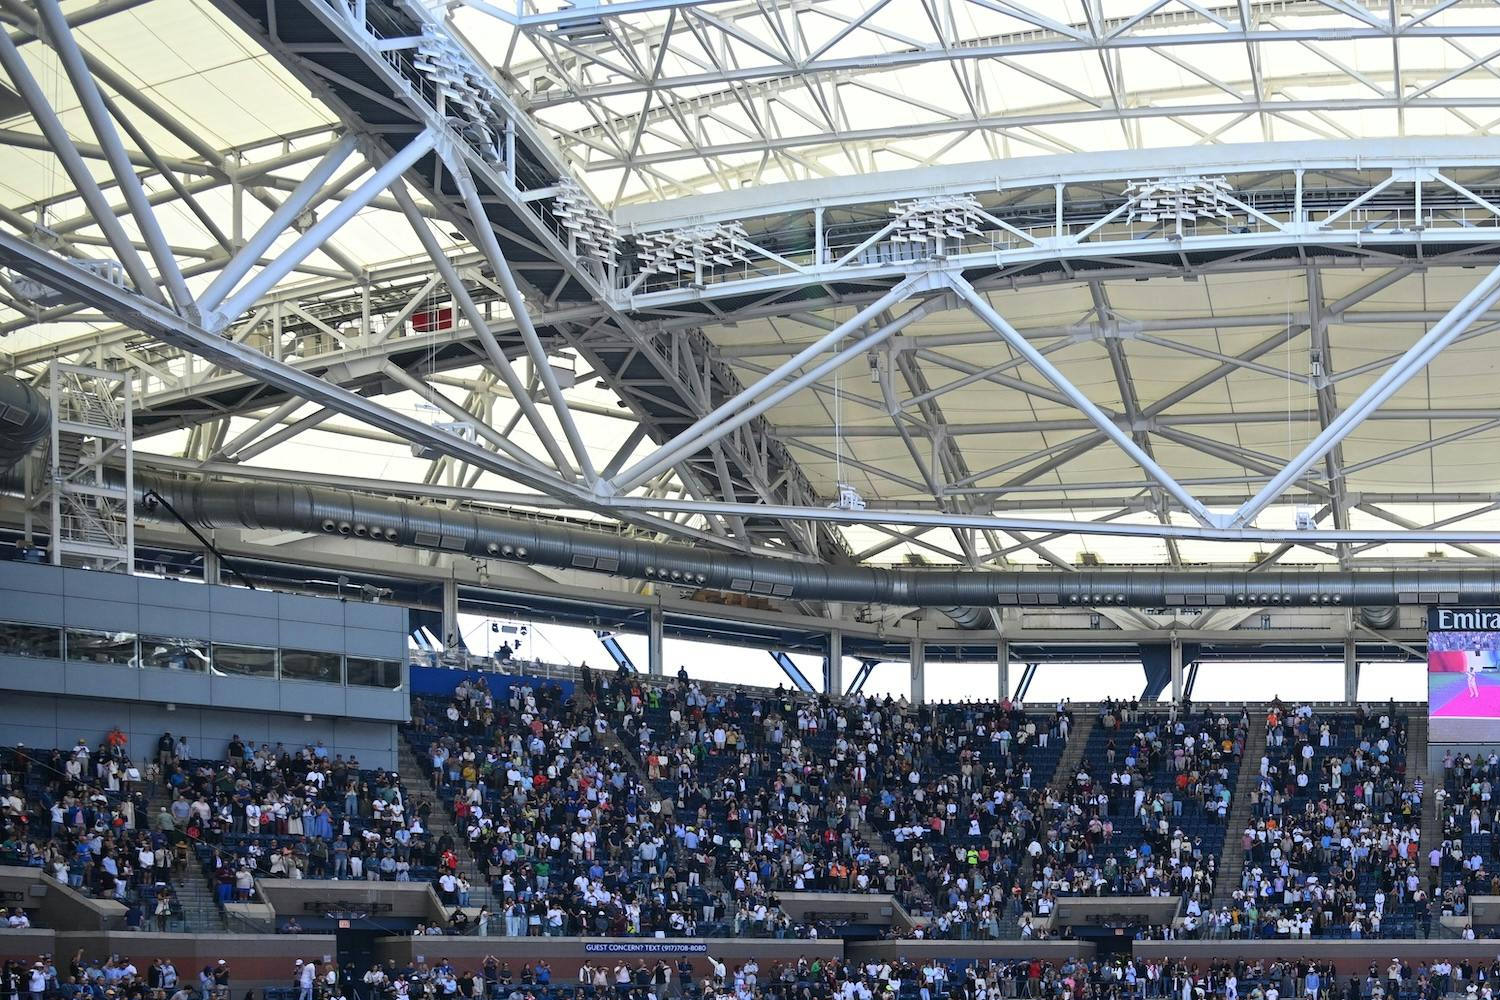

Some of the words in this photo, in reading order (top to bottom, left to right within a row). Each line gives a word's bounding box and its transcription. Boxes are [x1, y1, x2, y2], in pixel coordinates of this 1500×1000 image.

[586, 944, 607, 952] GUEST
[609, 944, 643, 952] CONCERN?
[645, 944, 660, 952] TEXT
